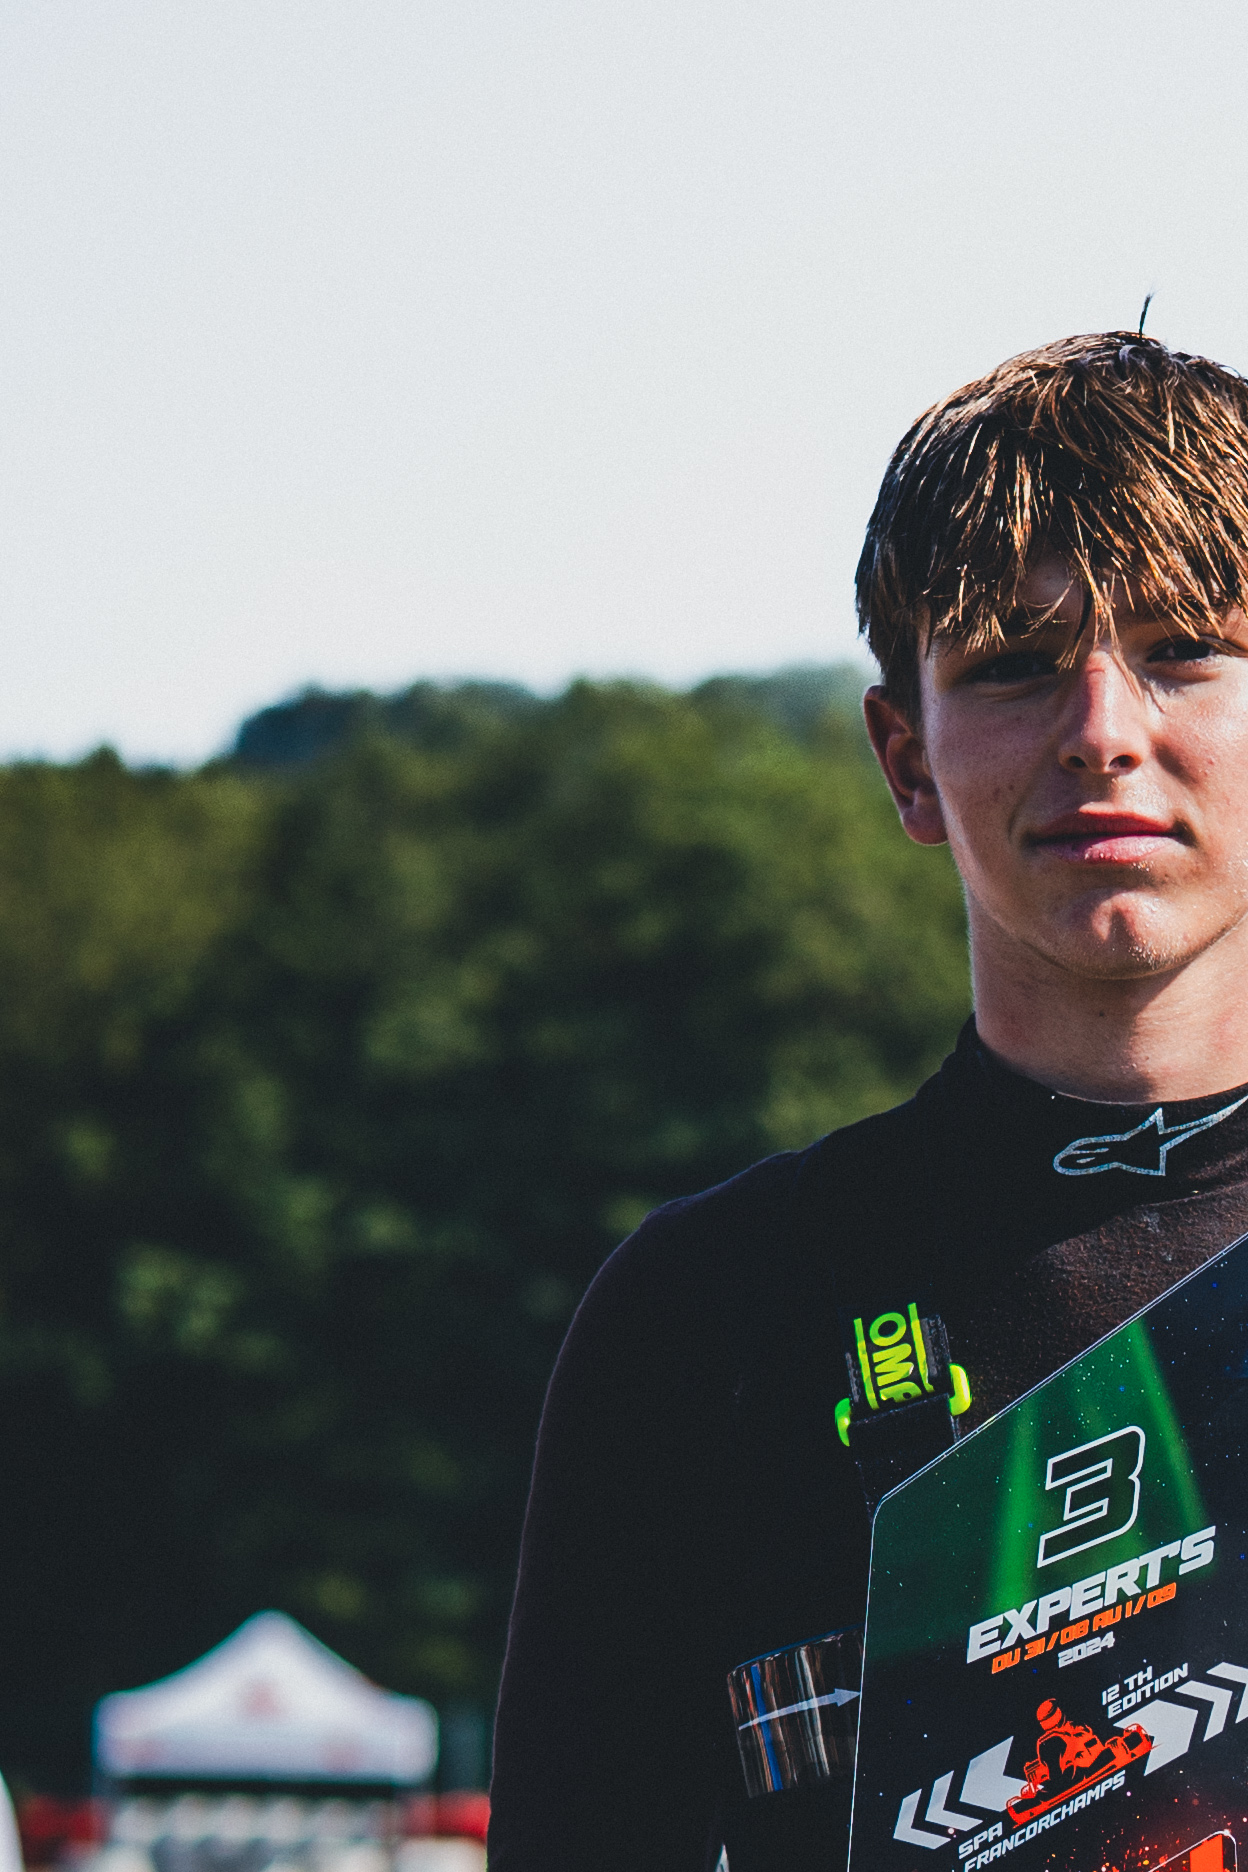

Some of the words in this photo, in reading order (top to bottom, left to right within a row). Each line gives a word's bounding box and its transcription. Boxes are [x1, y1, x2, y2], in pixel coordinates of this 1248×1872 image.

[1037, 1425, 1145, 1568] 3
[991, 1648, 1021, 1674] DU
[1092, 1605, 1122, 1632] AU
[1058, 1631, 1115, 1668] 2024
[1102, 1684, 1120, 1705] 12
[1124, 1666, 1153, 1691] TH
[1107, 1663, 1189, 1719] EDITION
[958, 1821, 1003, 1860] SPA
